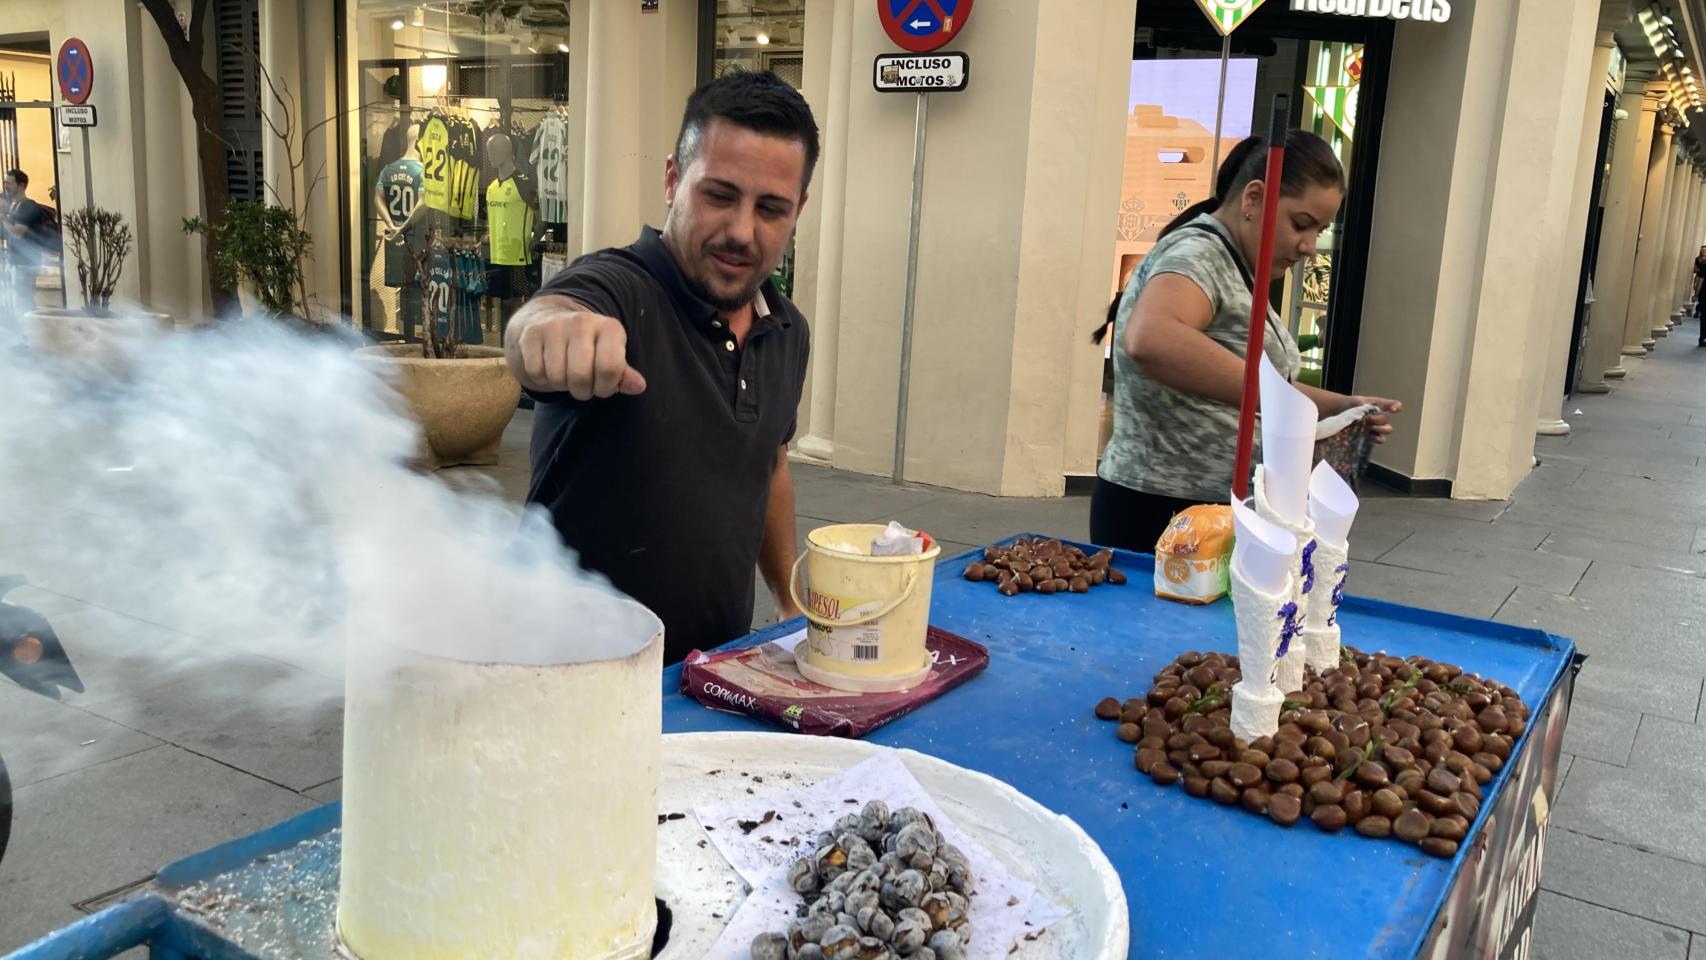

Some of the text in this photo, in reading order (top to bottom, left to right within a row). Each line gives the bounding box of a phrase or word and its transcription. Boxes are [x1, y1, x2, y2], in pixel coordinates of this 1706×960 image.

[896, 75, 944, 86] MOTOS
[425, 147, 446, 181] 22
[389, 183, 414, 217] 20
[703, 682, 757, 710] COPIMAX
